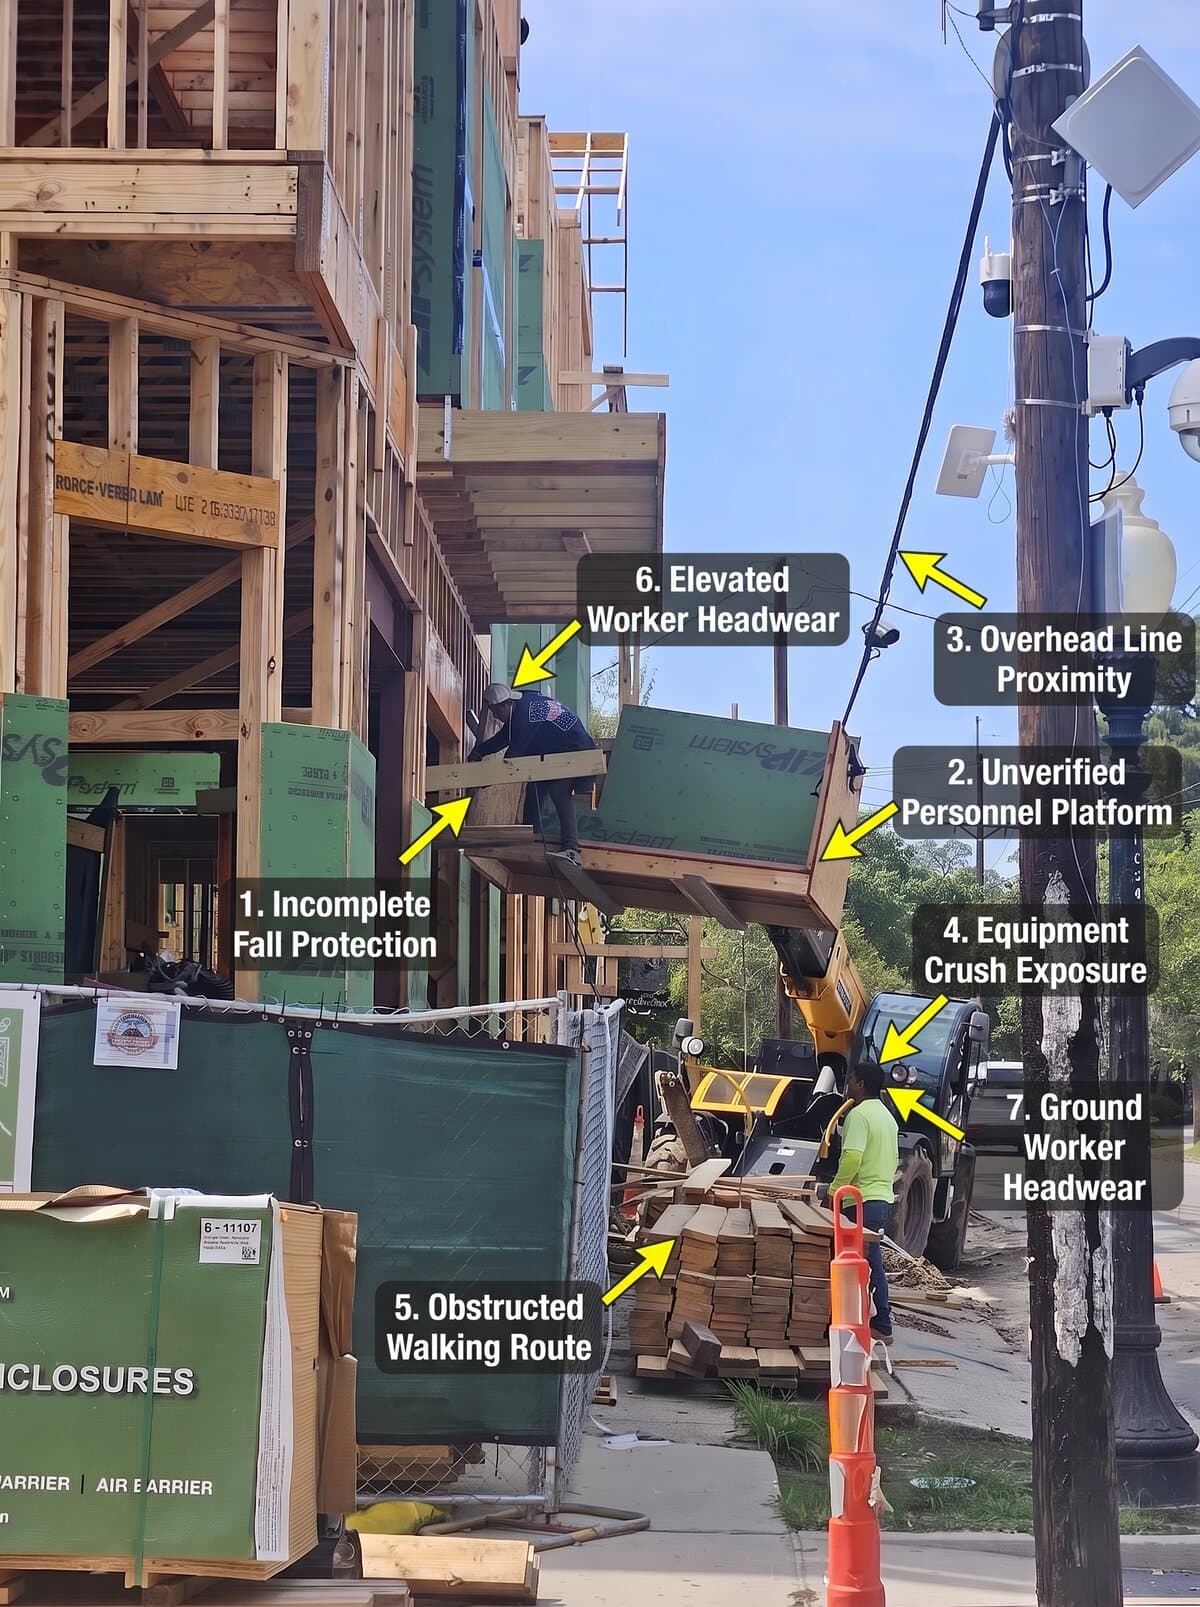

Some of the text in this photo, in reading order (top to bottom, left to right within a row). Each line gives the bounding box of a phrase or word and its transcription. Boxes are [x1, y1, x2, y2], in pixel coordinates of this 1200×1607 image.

[204, 1222, 212, 1233] 6
[223, 1223, 257, 1233] 11107
[0, 1475, 70, 1491] ARRIER
[96, 1478, 128, 1493] AIR
